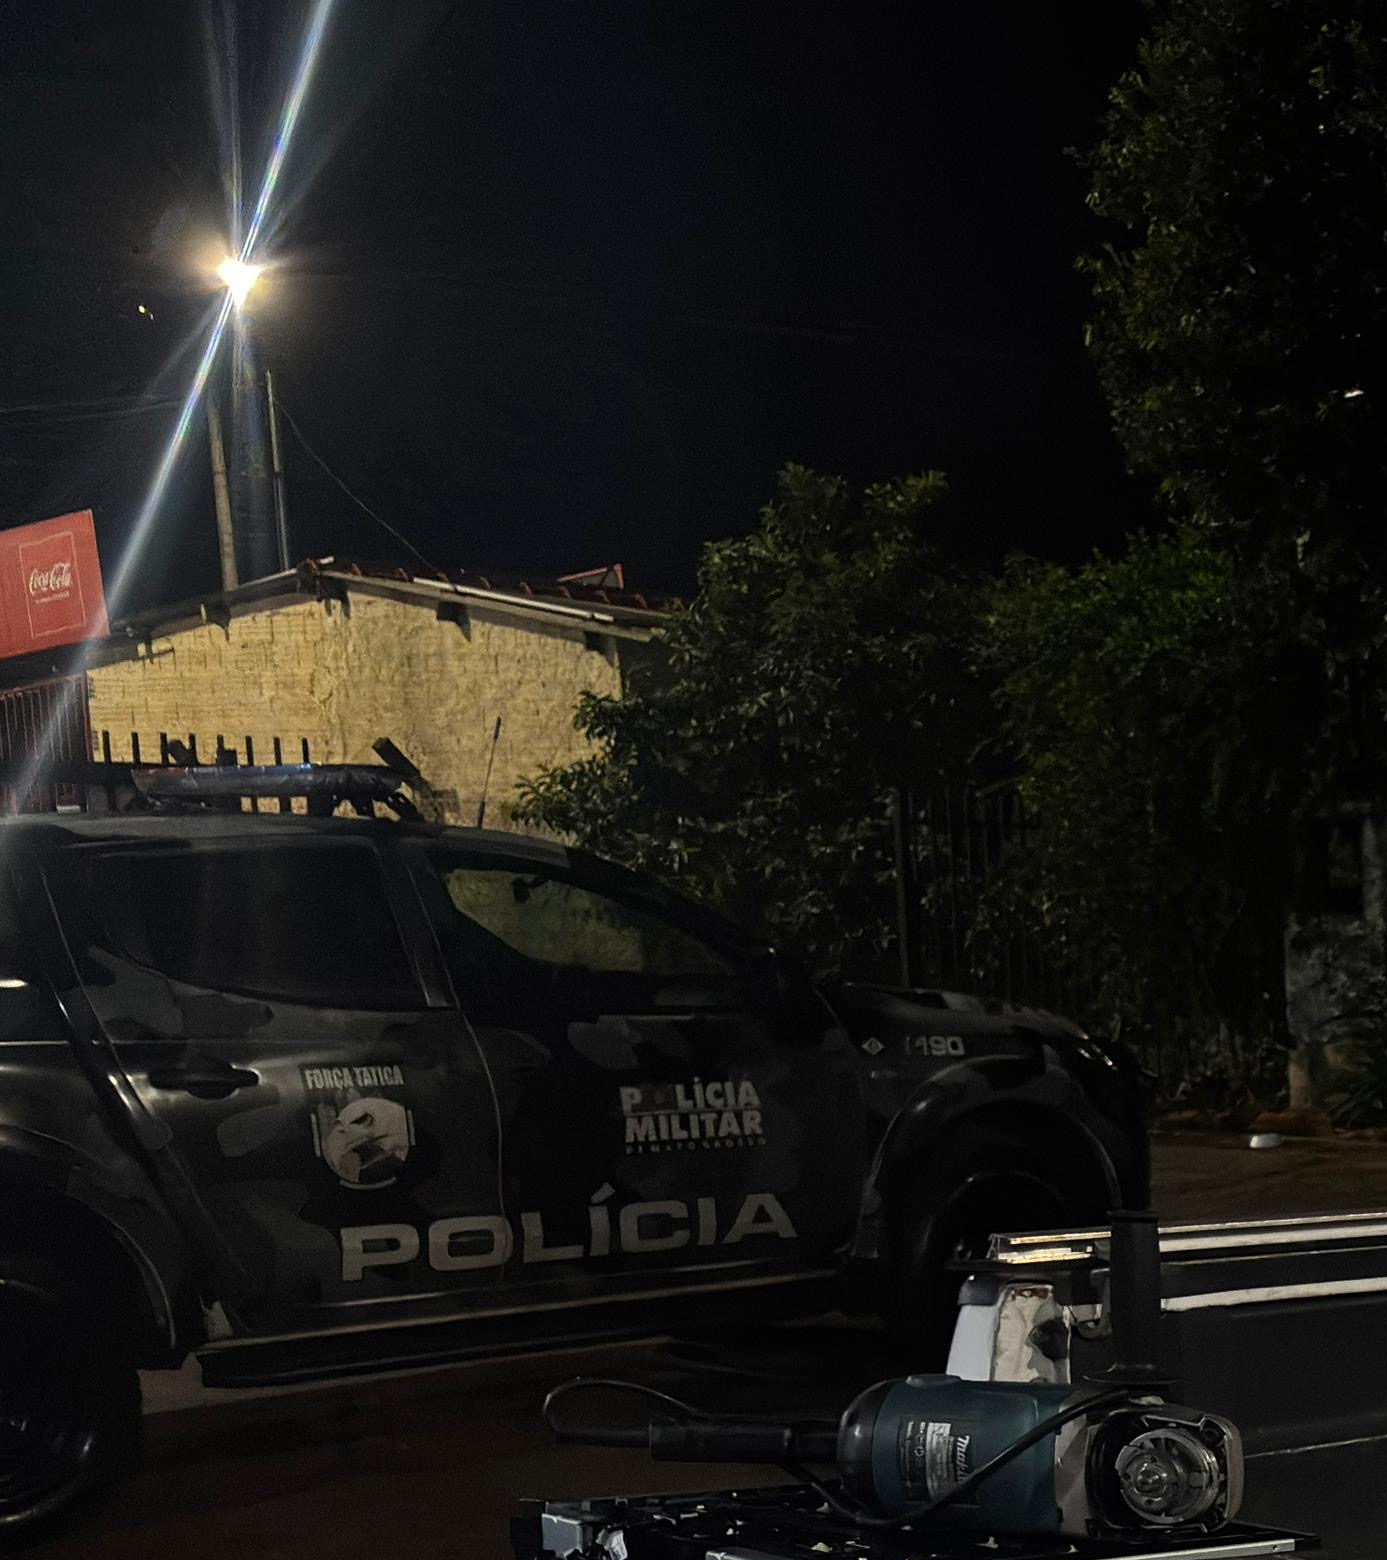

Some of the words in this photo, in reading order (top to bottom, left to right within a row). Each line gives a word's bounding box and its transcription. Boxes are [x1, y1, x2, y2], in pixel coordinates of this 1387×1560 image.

[619, 1075, 762, 1114] PLÍCIA
[625, 1109, 764, 1143] MILITAR
[339, 1181, 799, 1282] POLÍCIA
